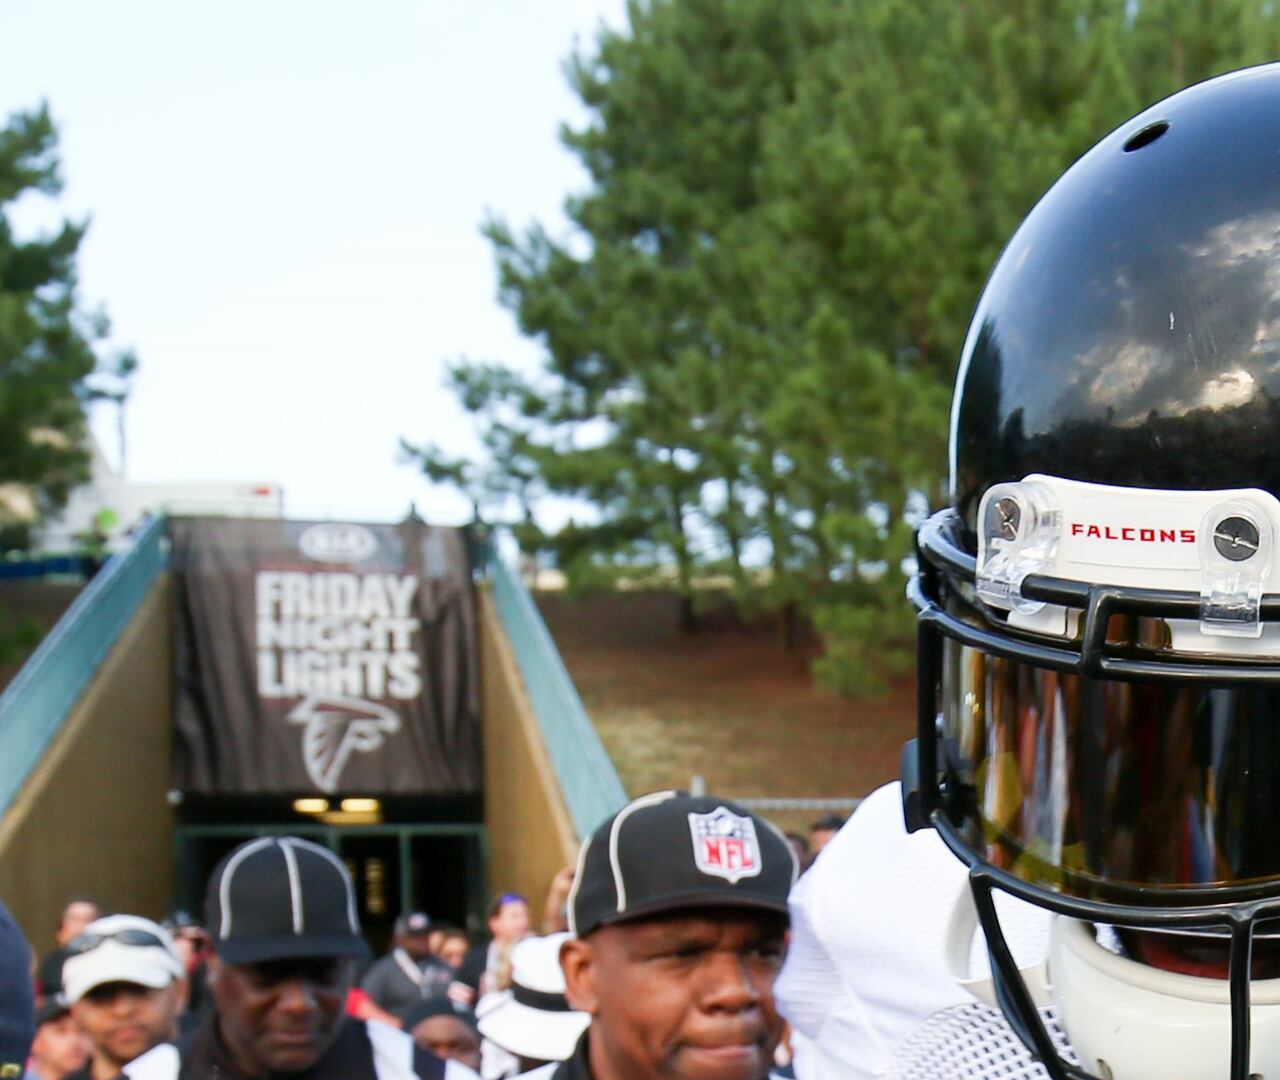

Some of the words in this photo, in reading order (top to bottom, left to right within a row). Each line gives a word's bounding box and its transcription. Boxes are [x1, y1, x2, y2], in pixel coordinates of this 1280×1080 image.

[1071, 523, 1196, 543] FALCONS
[256, 570, 419, 618] FRIDAY
[257, 617, 419, 651] NIGHT
[258, 651, 421, 700] LIGHTS
[704, 837, 754, 869] NFL
